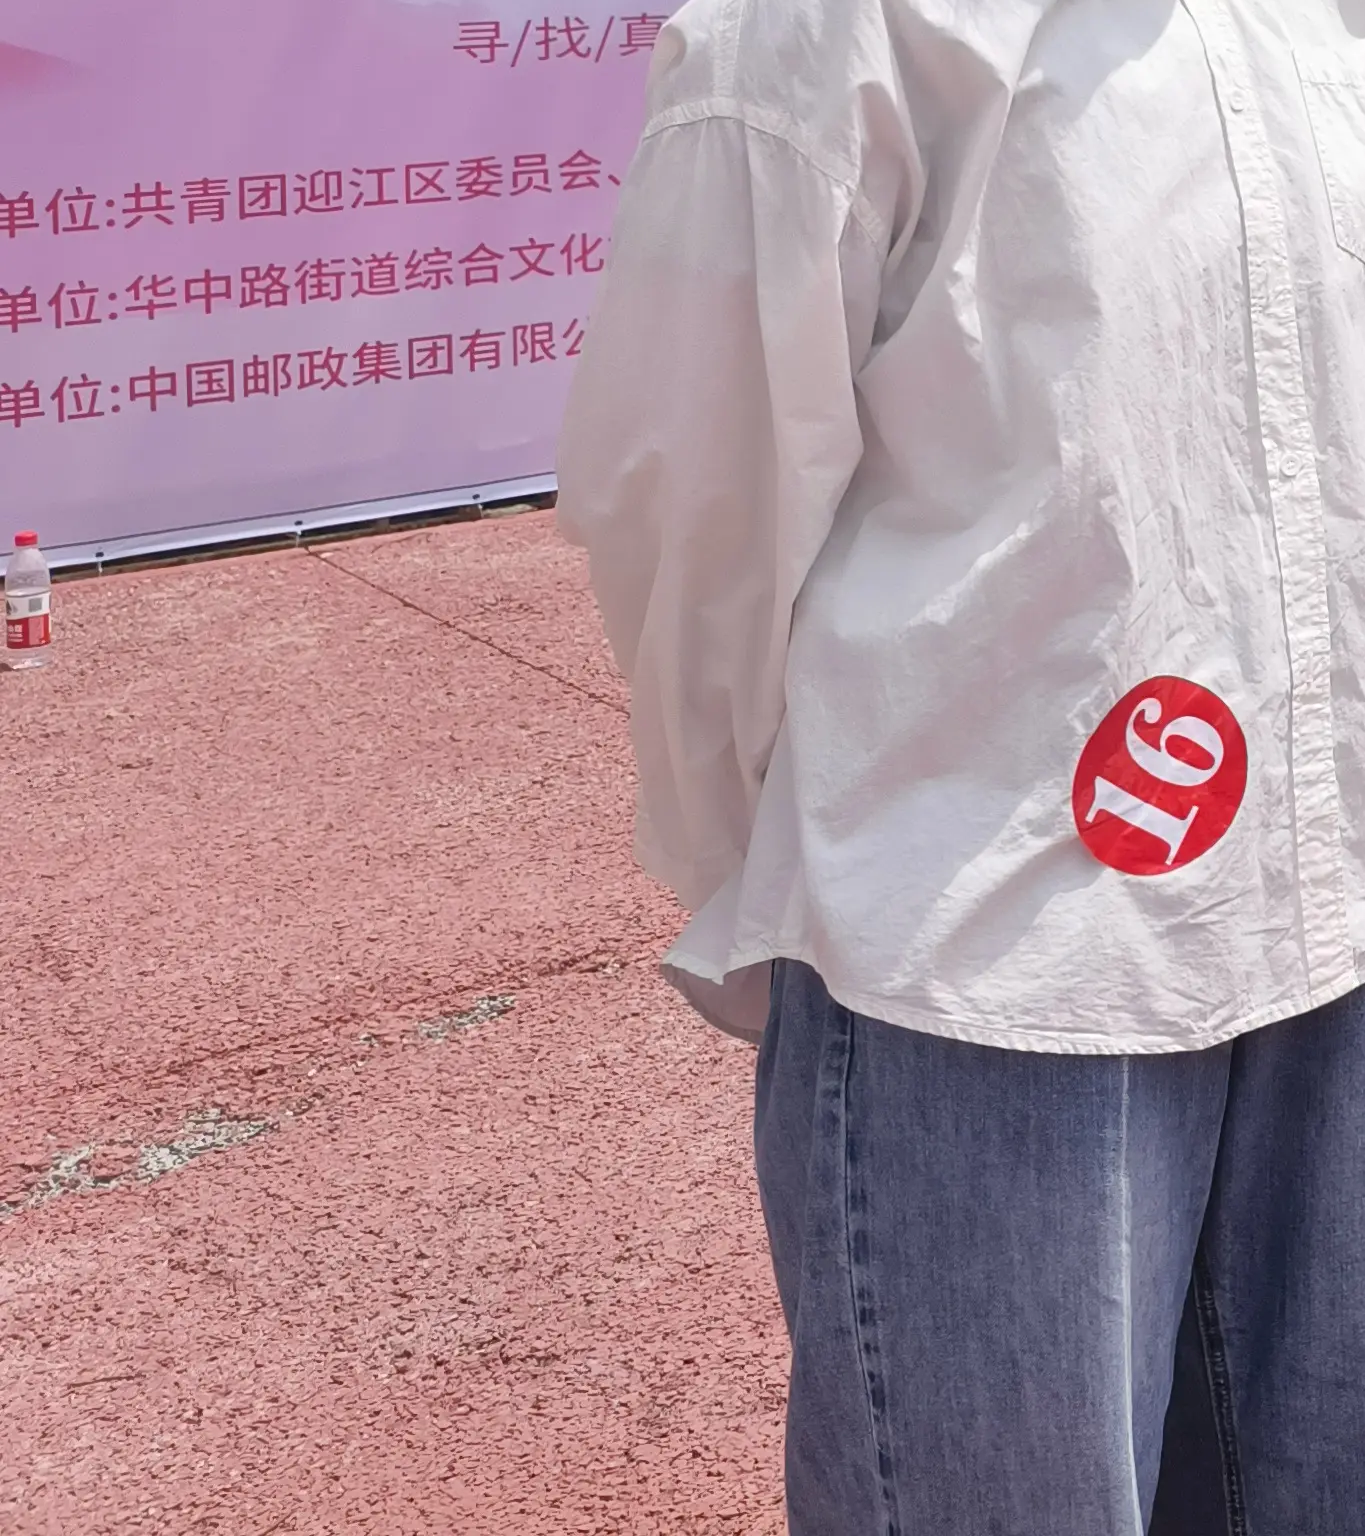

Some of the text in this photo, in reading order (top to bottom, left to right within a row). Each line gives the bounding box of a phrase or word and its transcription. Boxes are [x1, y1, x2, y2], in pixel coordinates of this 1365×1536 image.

[453, 13, 669, 67] 寻/找/真
[0, 233, 610, 333] 单位:华中路街道综合文化
[1085, 697, 1225, 865] 16
